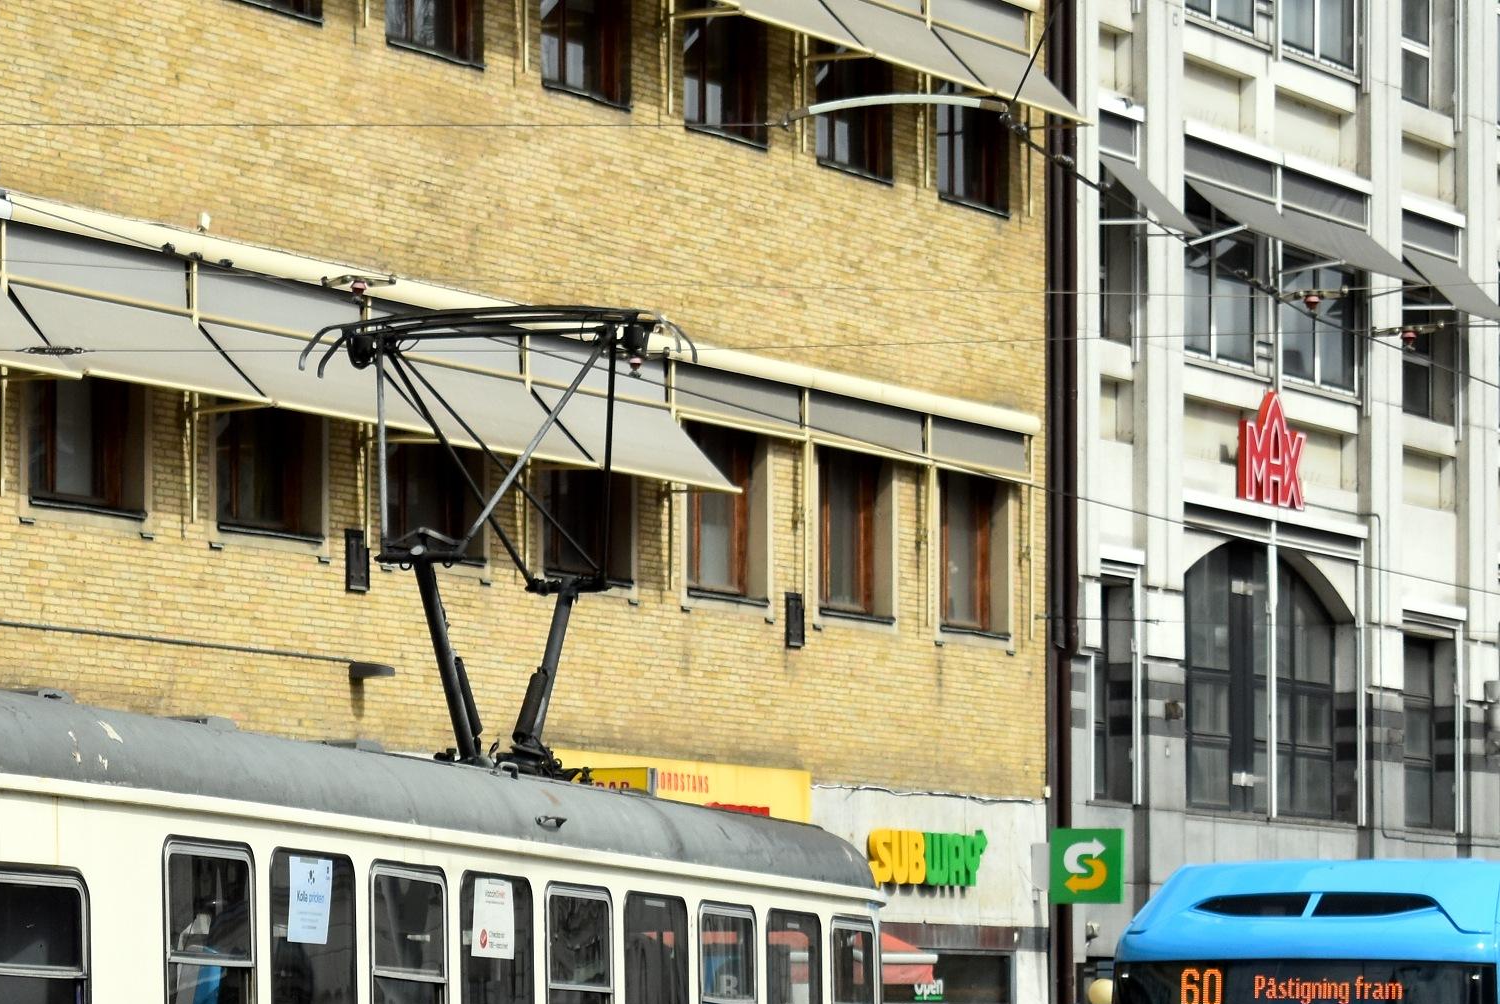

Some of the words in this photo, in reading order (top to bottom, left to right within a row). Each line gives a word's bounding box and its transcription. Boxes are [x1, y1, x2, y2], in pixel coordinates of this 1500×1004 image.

[1237, 391, 1307, 511] MAX
[869, 829, 988, 888] SUBWAY
[1355, 976, 1403, 1000] fram
